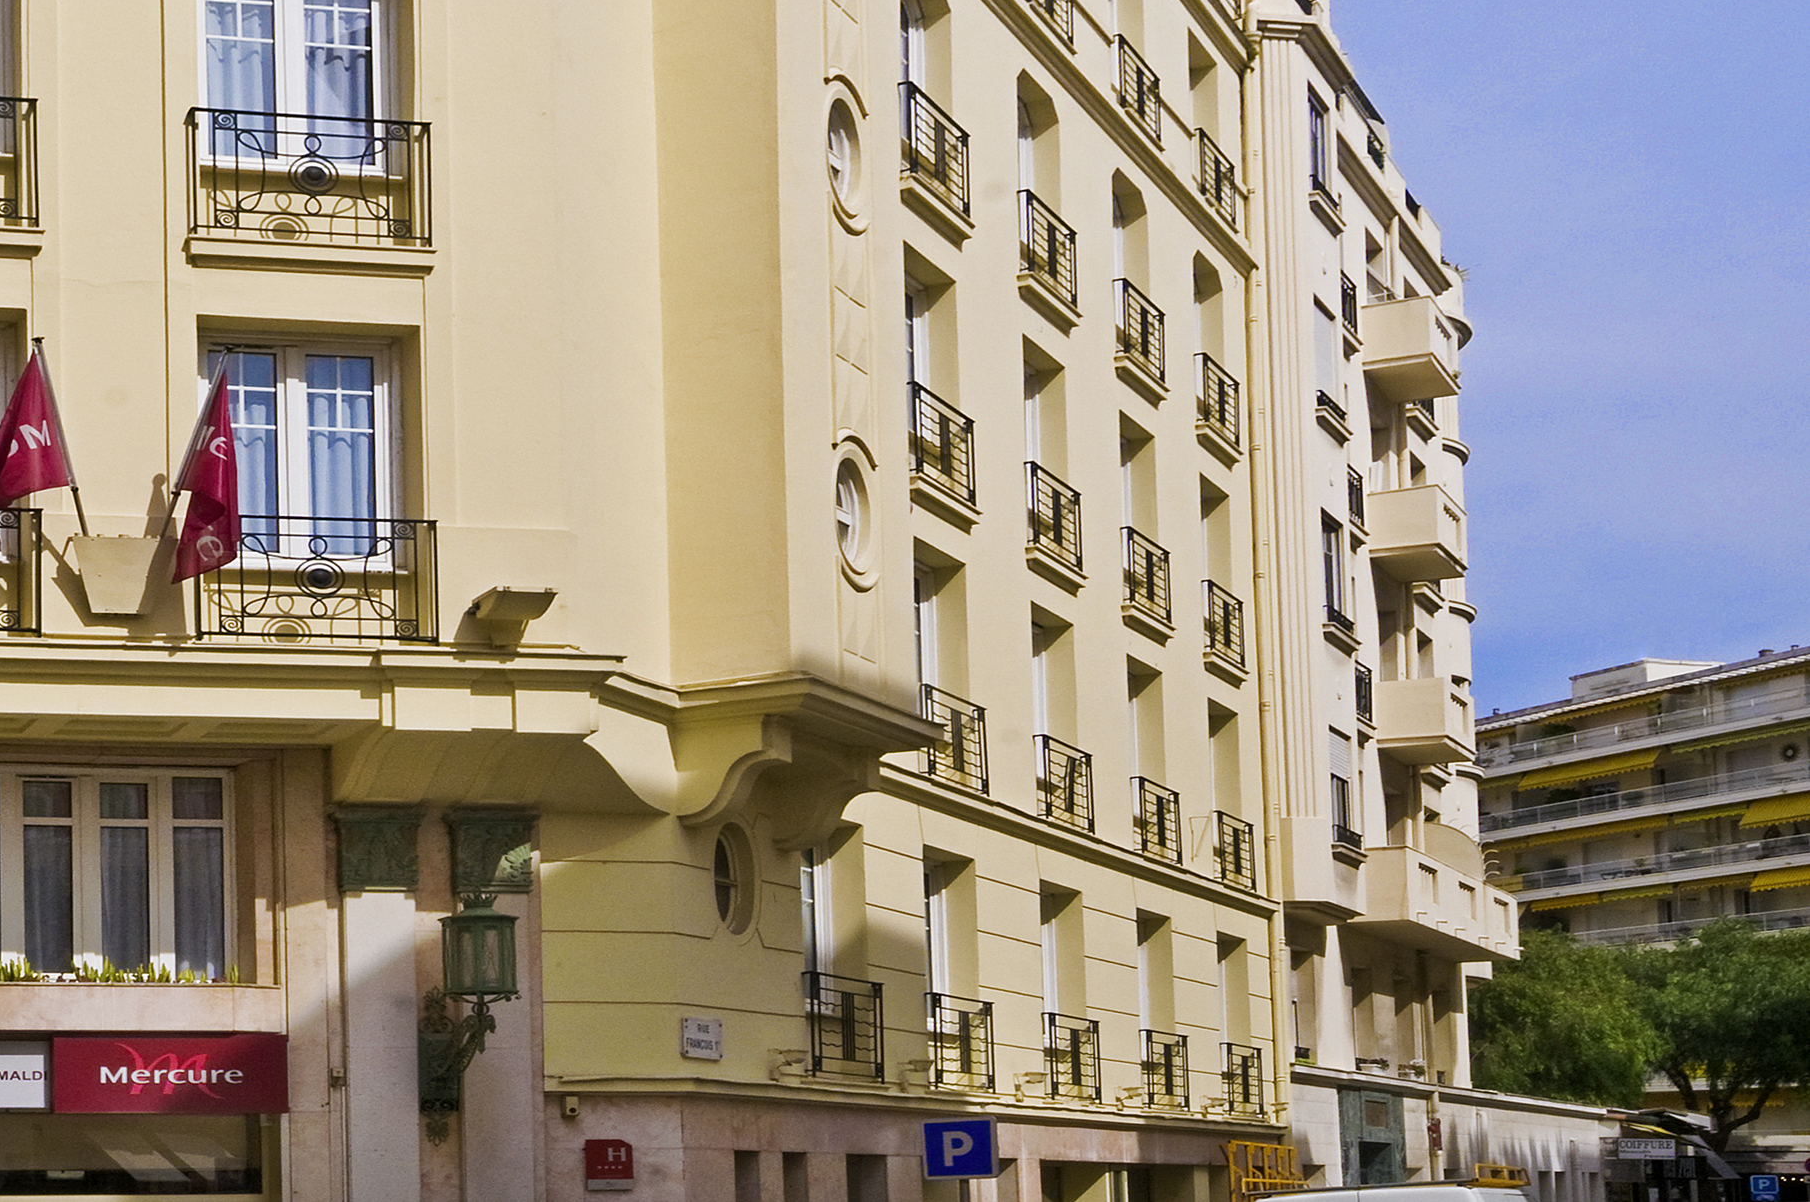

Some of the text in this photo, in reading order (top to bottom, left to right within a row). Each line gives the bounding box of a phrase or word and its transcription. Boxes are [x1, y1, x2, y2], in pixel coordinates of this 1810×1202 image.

[99, 1066, 244, 1085] Mercure
[942, 1130, 974, 1167] P
[1619, 1139, 1673, 1150] COIFFURE
[607, 1147, 627, 1162] H
[1758, 1178, 1770, 1190] P
